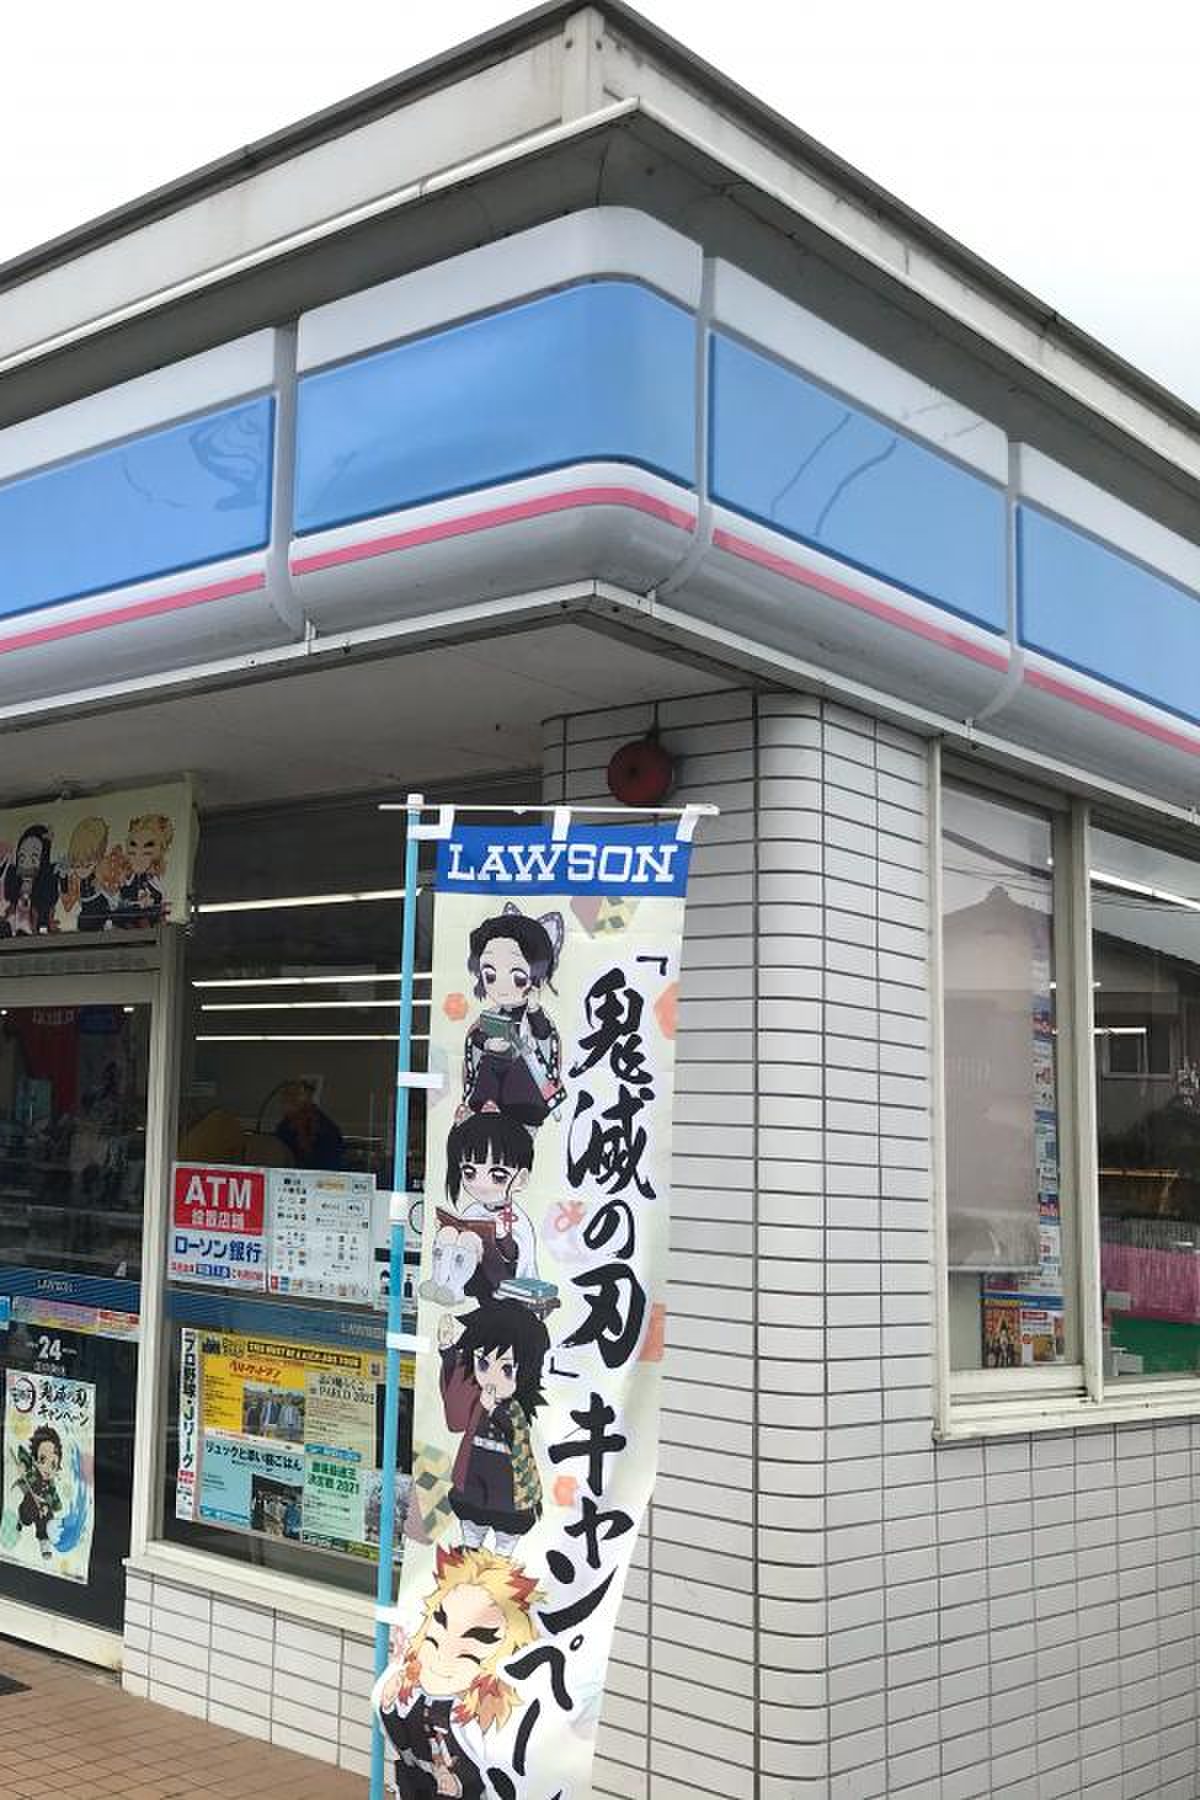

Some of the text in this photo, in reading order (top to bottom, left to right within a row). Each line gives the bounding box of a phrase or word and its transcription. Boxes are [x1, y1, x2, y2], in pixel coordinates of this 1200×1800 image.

[446, 843, 678, 882] LAWSON
[184, 1174, 252, 1210] ATM
[174, 1235, 263, 1264] ローソン銀行
[38, 1335, 63, 1361] 24
